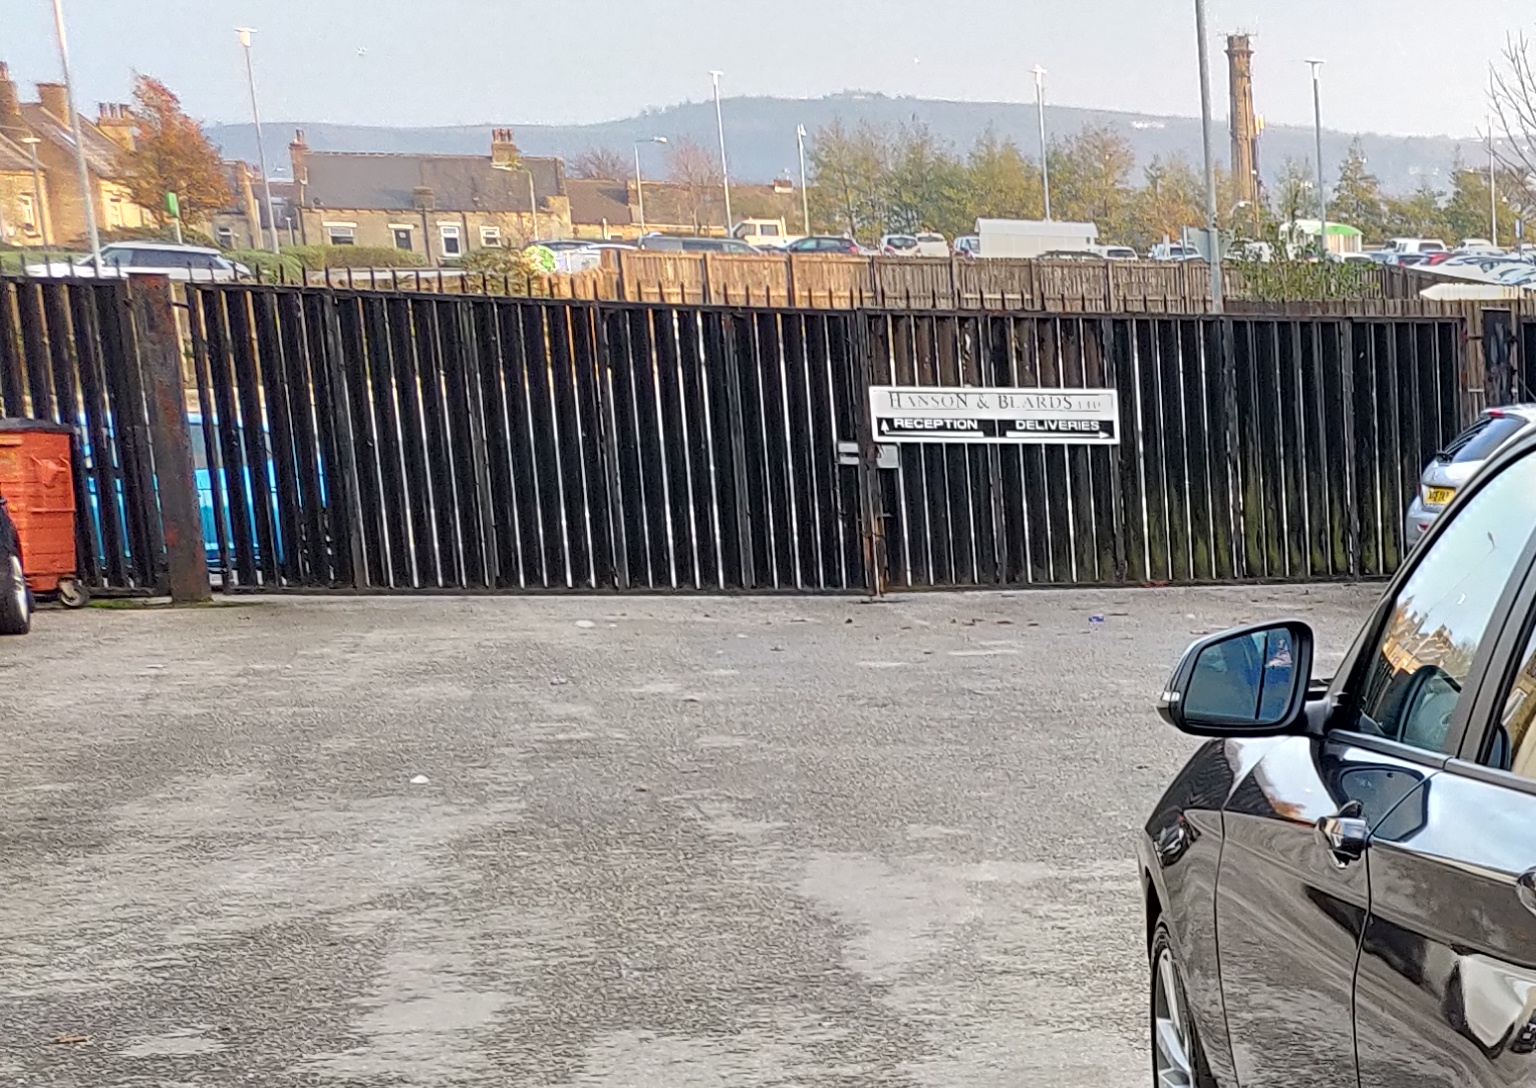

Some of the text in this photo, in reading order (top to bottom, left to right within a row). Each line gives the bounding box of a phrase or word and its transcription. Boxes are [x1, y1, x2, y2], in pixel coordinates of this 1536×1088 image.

[888, 392, 968, 410] HANSON
[977, 395, 990, 410] &
[893, 418, 978, 431] RECEPTION
[1015, 419, 1101, 432] DELIVERIES
